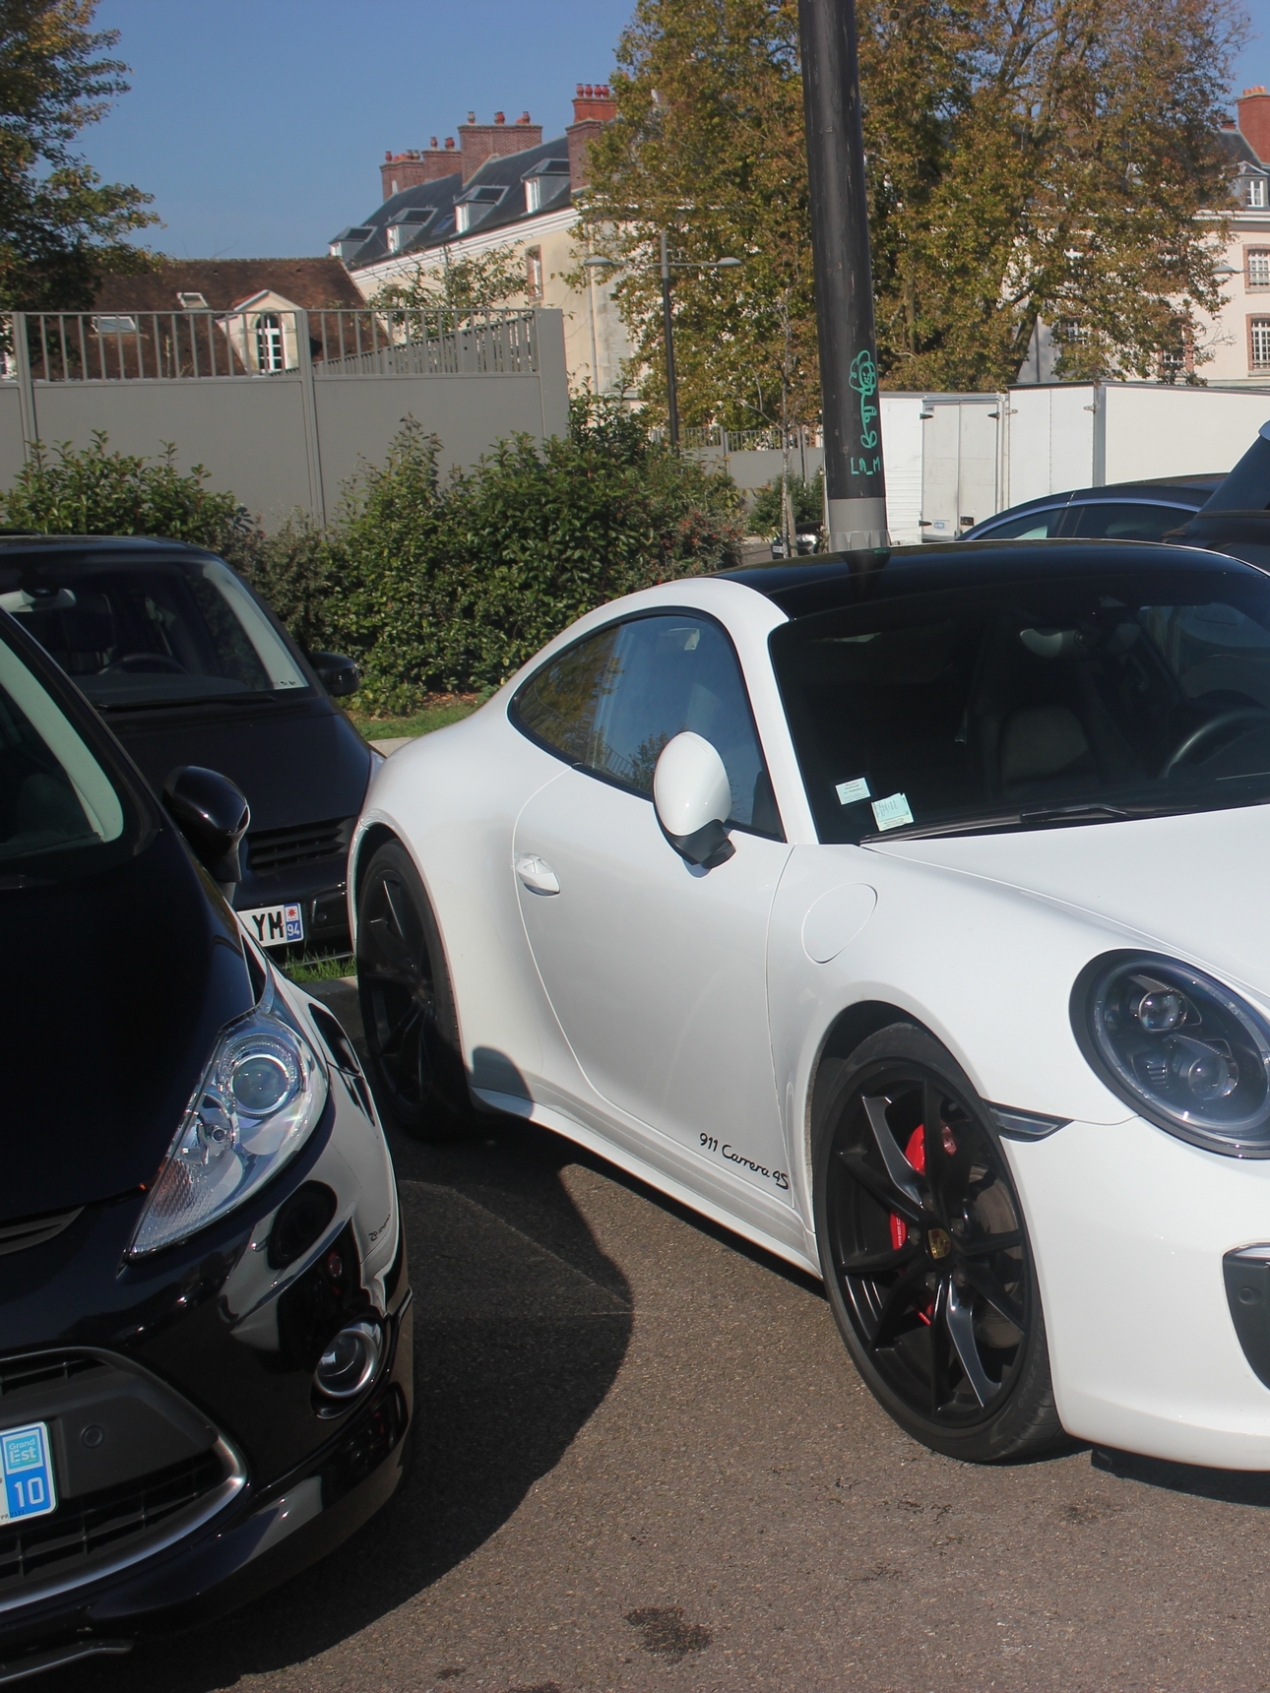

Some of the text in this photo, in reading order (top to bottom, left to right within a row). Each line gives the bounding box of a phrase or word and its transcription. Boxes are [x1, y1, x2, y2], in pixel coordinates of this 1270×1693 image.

[252, 911, 285, 941] YM
[286, 922, 301, 937] 94
[699, 1132, 719, 1153] 911
[721, 1144, 770, 1178] Carrera
[8, 1438, 36, 1451] Grand
[10, 1446, 37, 1464] Est
[14, 1476, 45, 1508] 10
